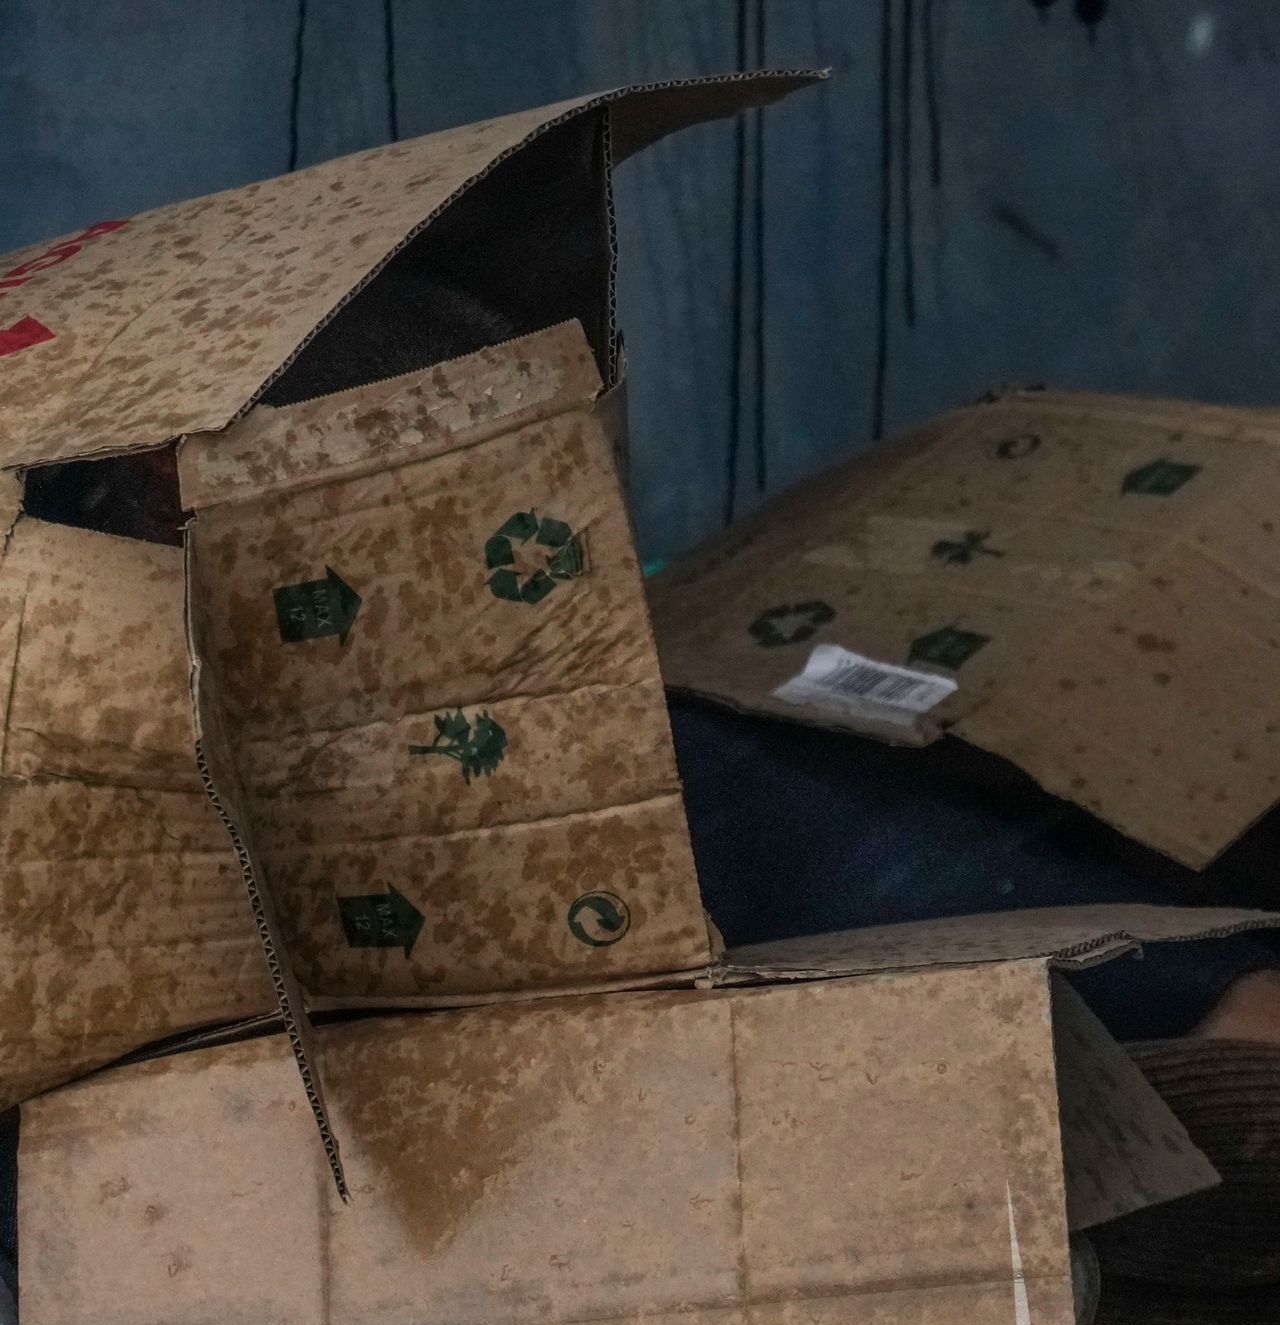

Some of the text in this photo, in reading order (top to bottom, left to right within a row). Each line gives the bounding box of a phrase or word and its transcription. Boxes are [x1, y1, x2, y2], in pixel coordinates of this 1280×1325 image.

[288, 606, 306, 623] 12
[311, 589, 332, 628] MAX
[354, 912, 368, 932] 12
[376, 902, 396, 938] MAX
